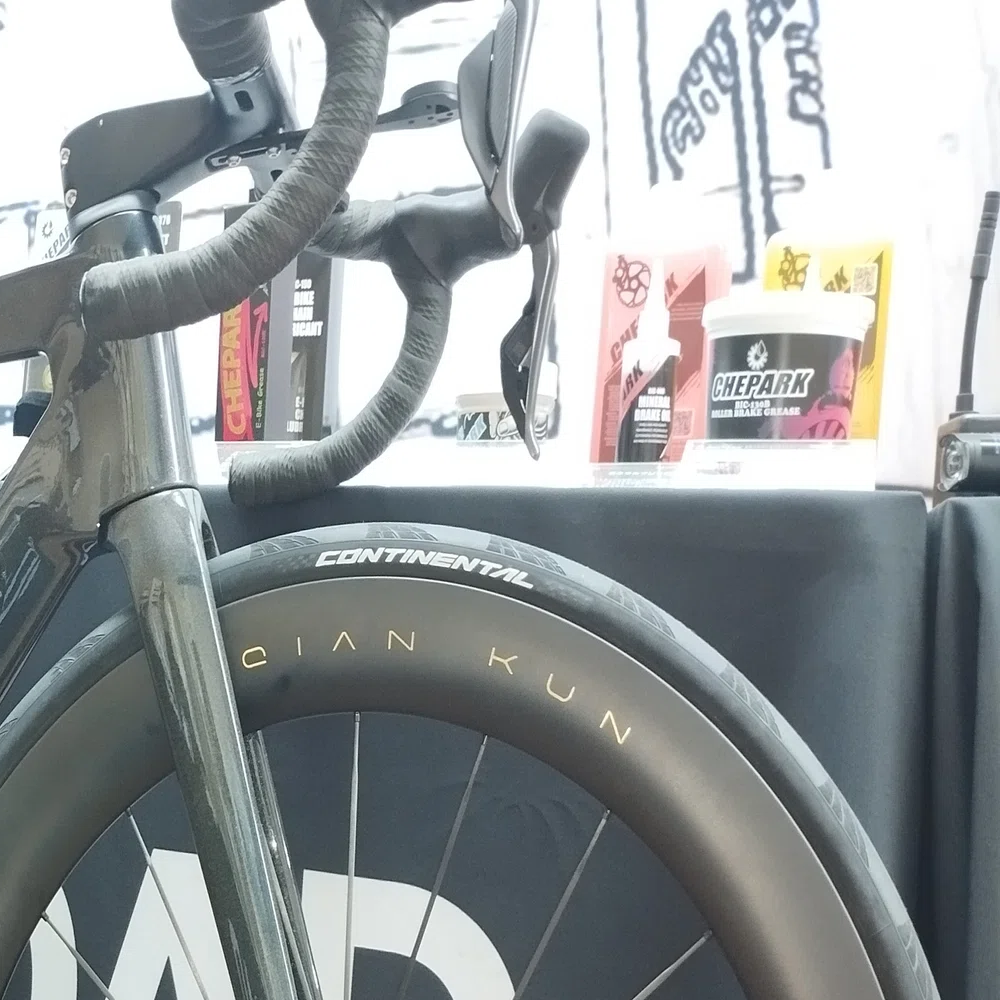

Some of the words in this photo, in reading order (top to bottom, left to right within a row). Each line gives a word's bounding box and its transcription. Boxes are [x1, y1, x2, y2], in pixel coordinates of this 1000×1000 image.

[221, 303, 246, 435] CHEPAR
[710, 368, 816, 402] CHEPARK
[634, 409, 661, 422] BRAKE
[637, 395, 671, 409] MINERAL
[733, 408, 762, 418] BRAKE
[763, 406, 801, 416] GREASE
[314, 546, 535, 590] CONTINENTAL
[487, 646, 632, 745] KUN
